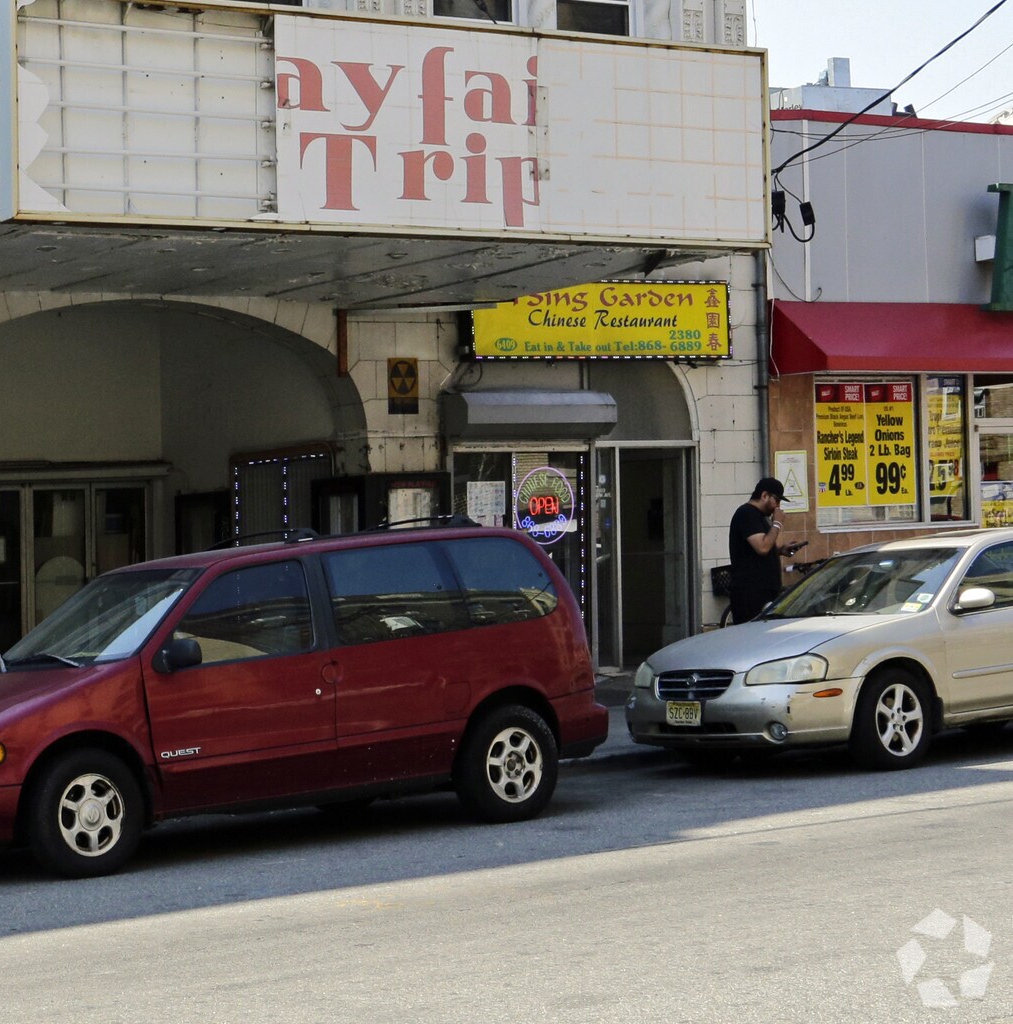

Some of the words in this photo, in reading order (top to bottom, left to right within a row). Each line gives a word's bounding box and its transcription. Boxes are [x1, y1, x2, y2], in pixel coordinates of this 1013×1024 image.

[600, 287, 694, 307] Garden
[528, 309, 587, 327] Chinese
[594, 309, 678, 330] Restaurant
[669, 329, 701, 340] 2380
[496, 338, 517, 351] 6409
[524, 342, 543, 352] Eat
[544, 341, 554, 351] in
[556, 341, 566, 351] &
[569, 340, 591, 352] Take
[596, 342, 612, 352] out
[670, 340, 702, 352] 6889
[876, 414, 903, 426] Yellow
[817, 430, 844, 444] Rancher's
[845, 430, 864, 446] Legend
[875, 429, 905, 441] Onions
[824, 447, 841, 460] Sirloin
[842, 447, 858, 460] Steak
[869, 444, 875, 456] 2
[878, 444, 891, 456] Lb.
[894, 443, 911, 457] Bag
[529, 496, 560, 516] OPEN
[160, 746, 202, 759] QUEST
